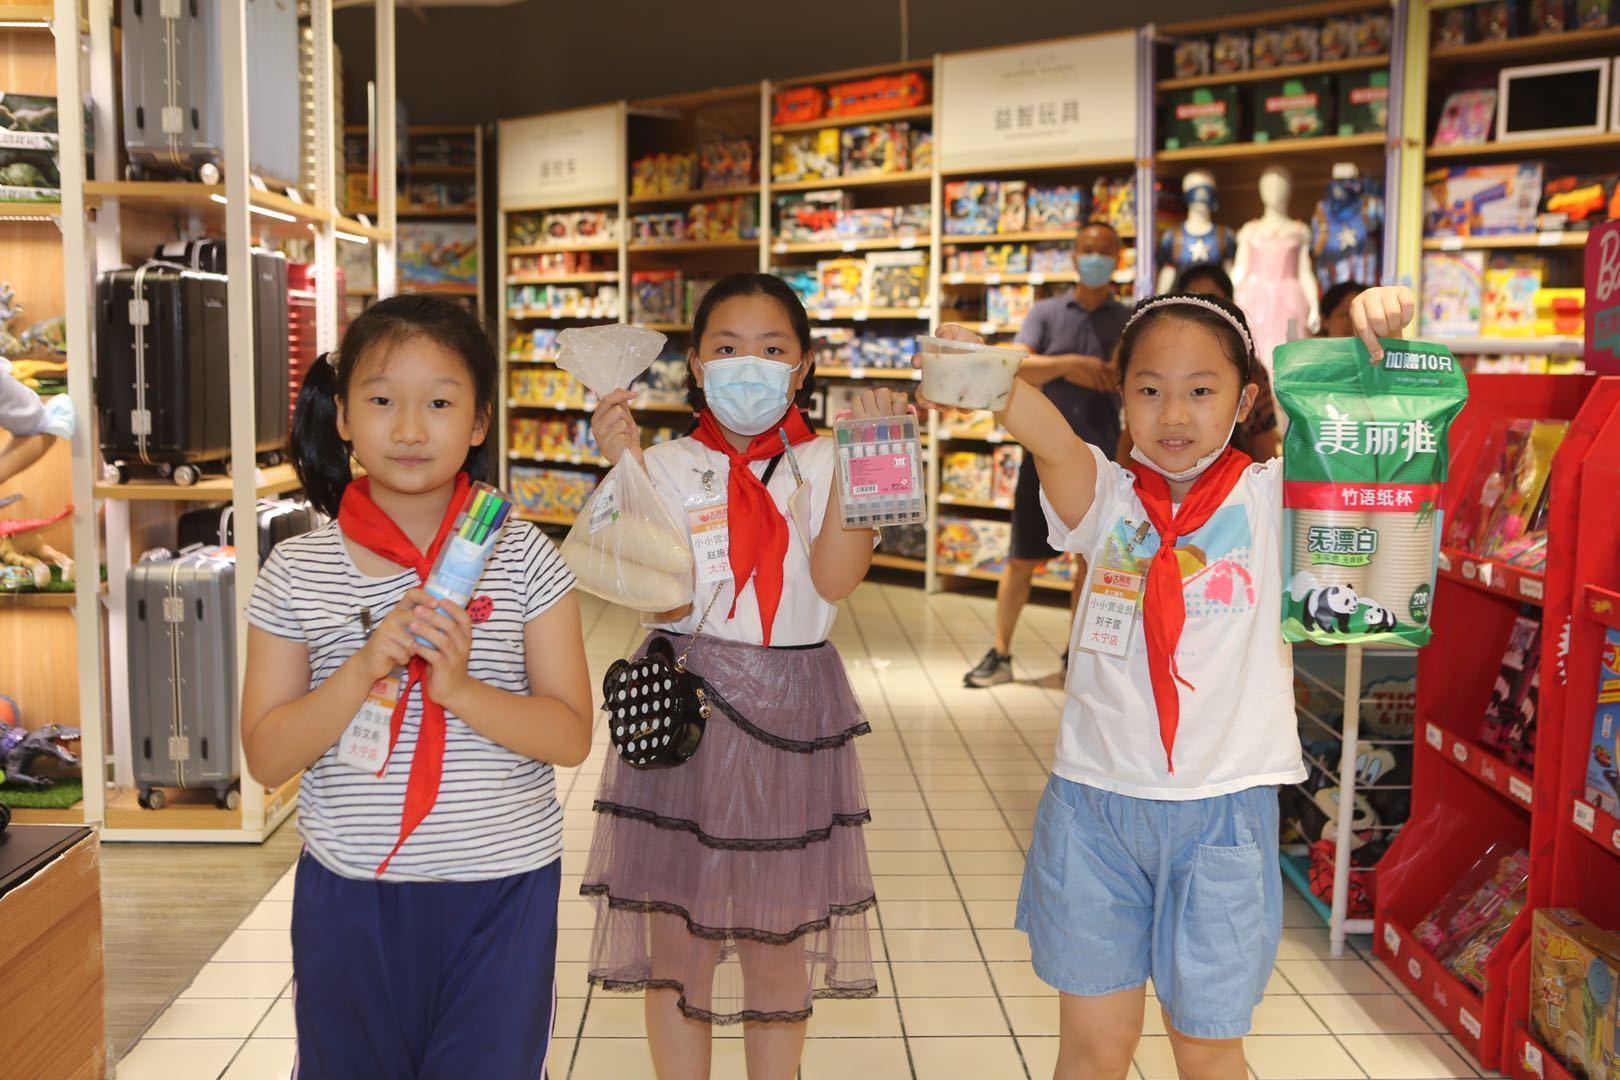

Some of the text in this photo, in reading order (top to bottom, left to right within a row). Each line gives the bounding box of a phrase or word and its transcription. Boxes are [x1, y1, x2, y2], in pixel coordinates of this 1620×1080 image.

[994, 99, 1080, 131] 益智玩具
[1384, 350, 1453, 371] 加赠10只
[1315, 410, 1437, 463] 美丽雅
[1341, 488, 1413, 507] 竹语纸杯
[1308, 527, 1377, 554] 无漂白
[1090, 598, 1133, 616] 小小营业员
[1091, 631, 1120, 646] 大宁店
